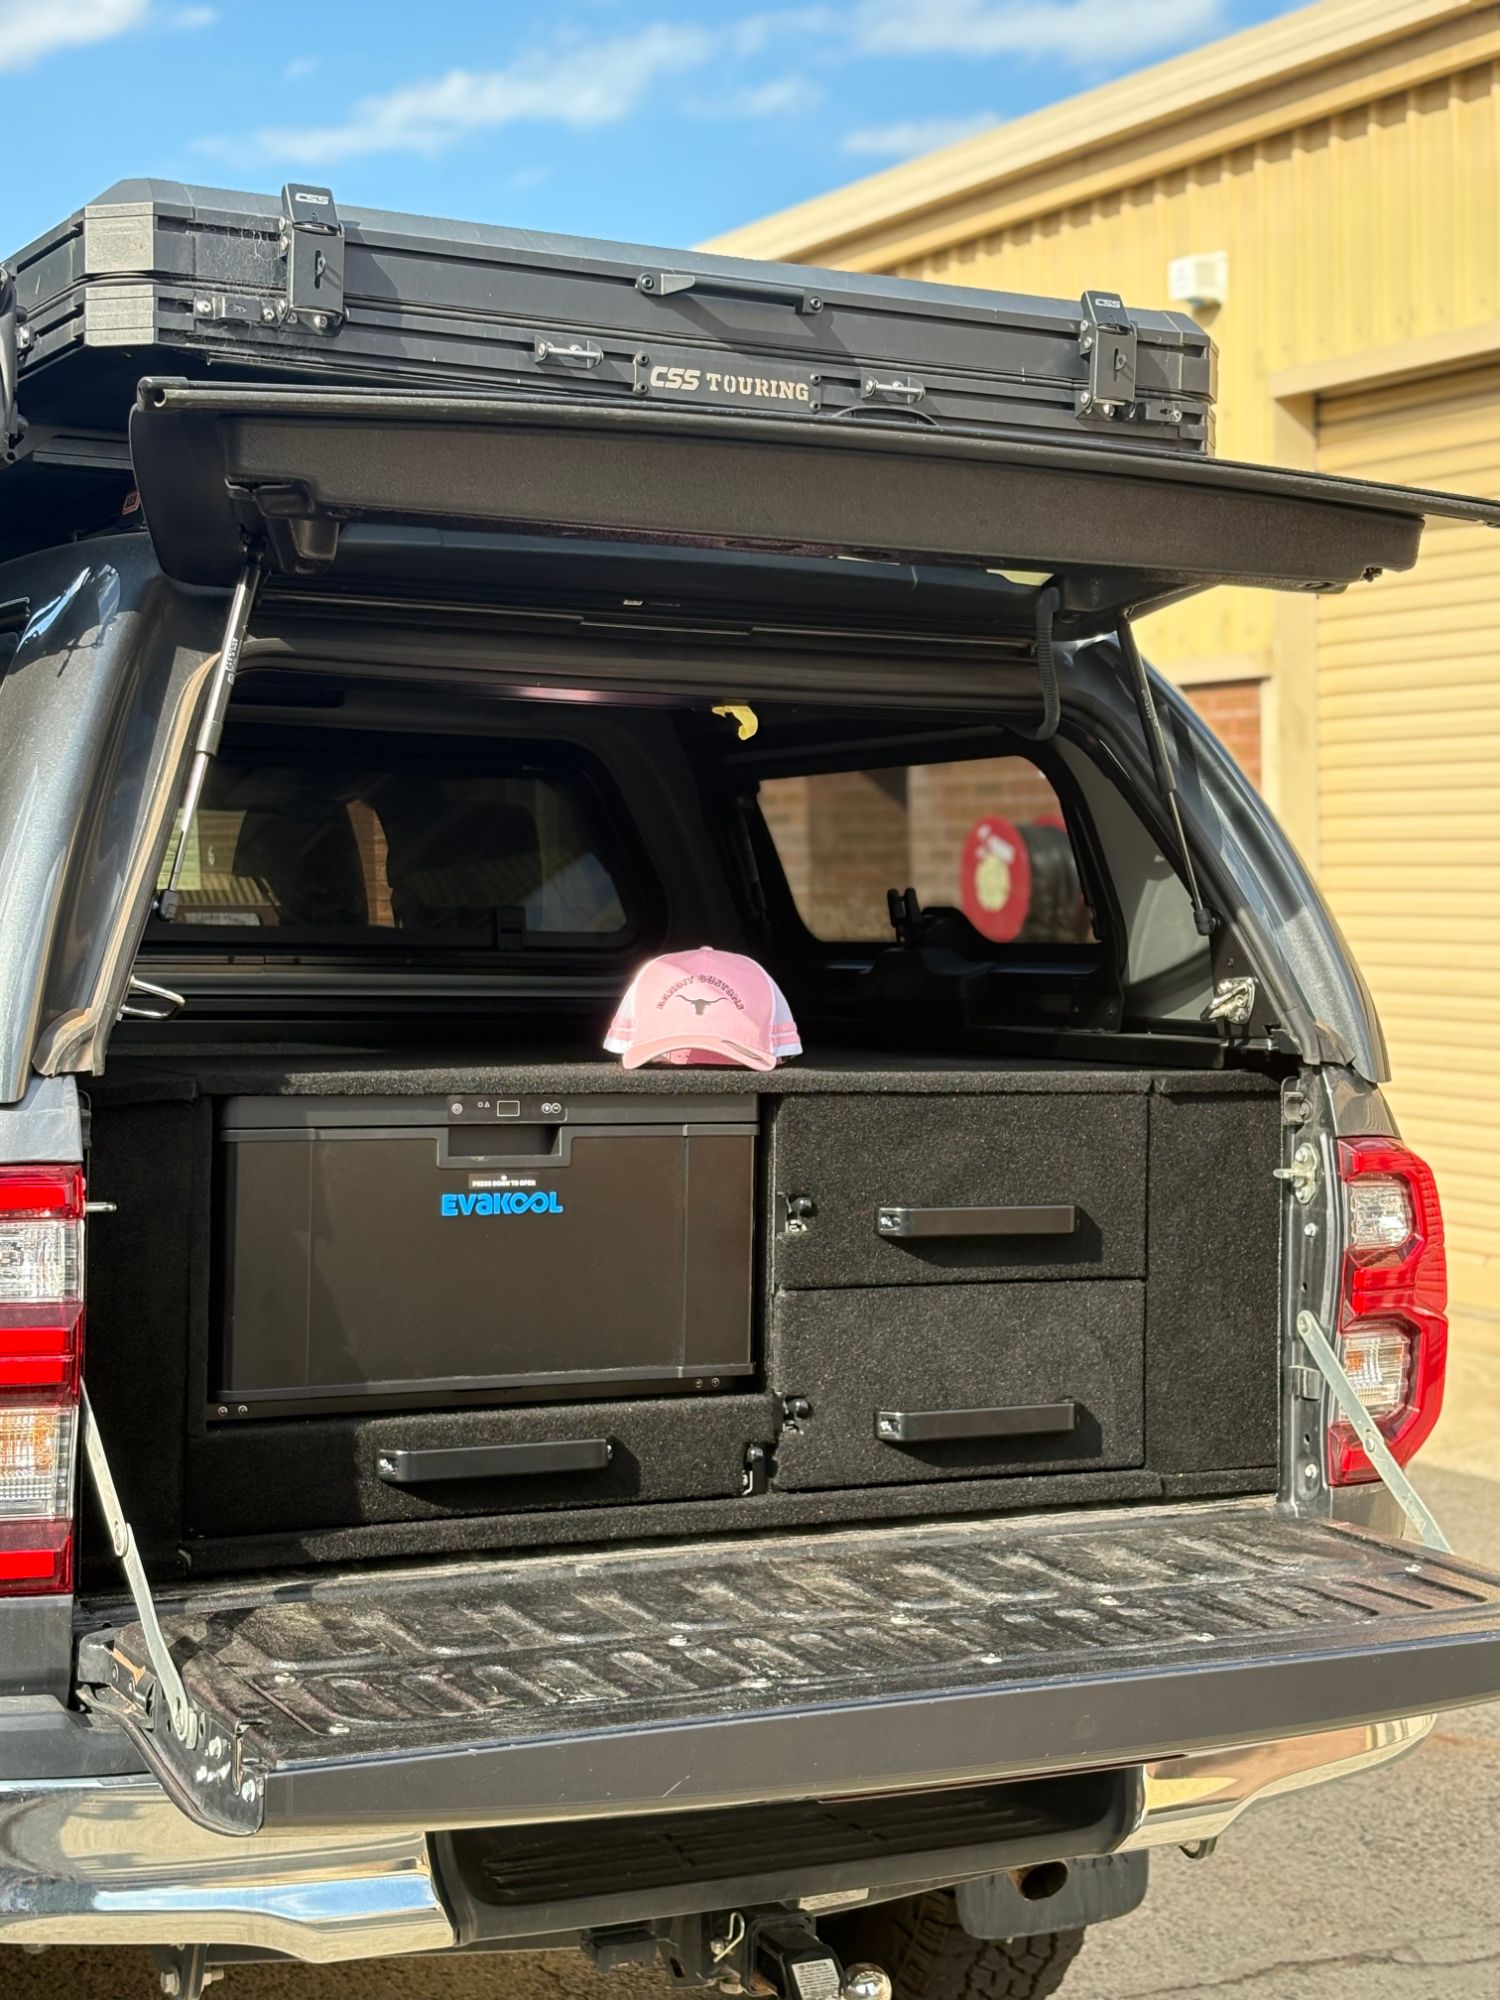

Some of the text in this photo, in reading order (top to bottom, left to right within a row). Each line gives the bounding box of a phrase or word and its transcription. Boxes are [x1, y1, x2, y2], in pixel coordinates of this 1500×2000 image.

[295, 192, 330, 205] CSS
[650, 365, 809, 401] CSS TOURING
